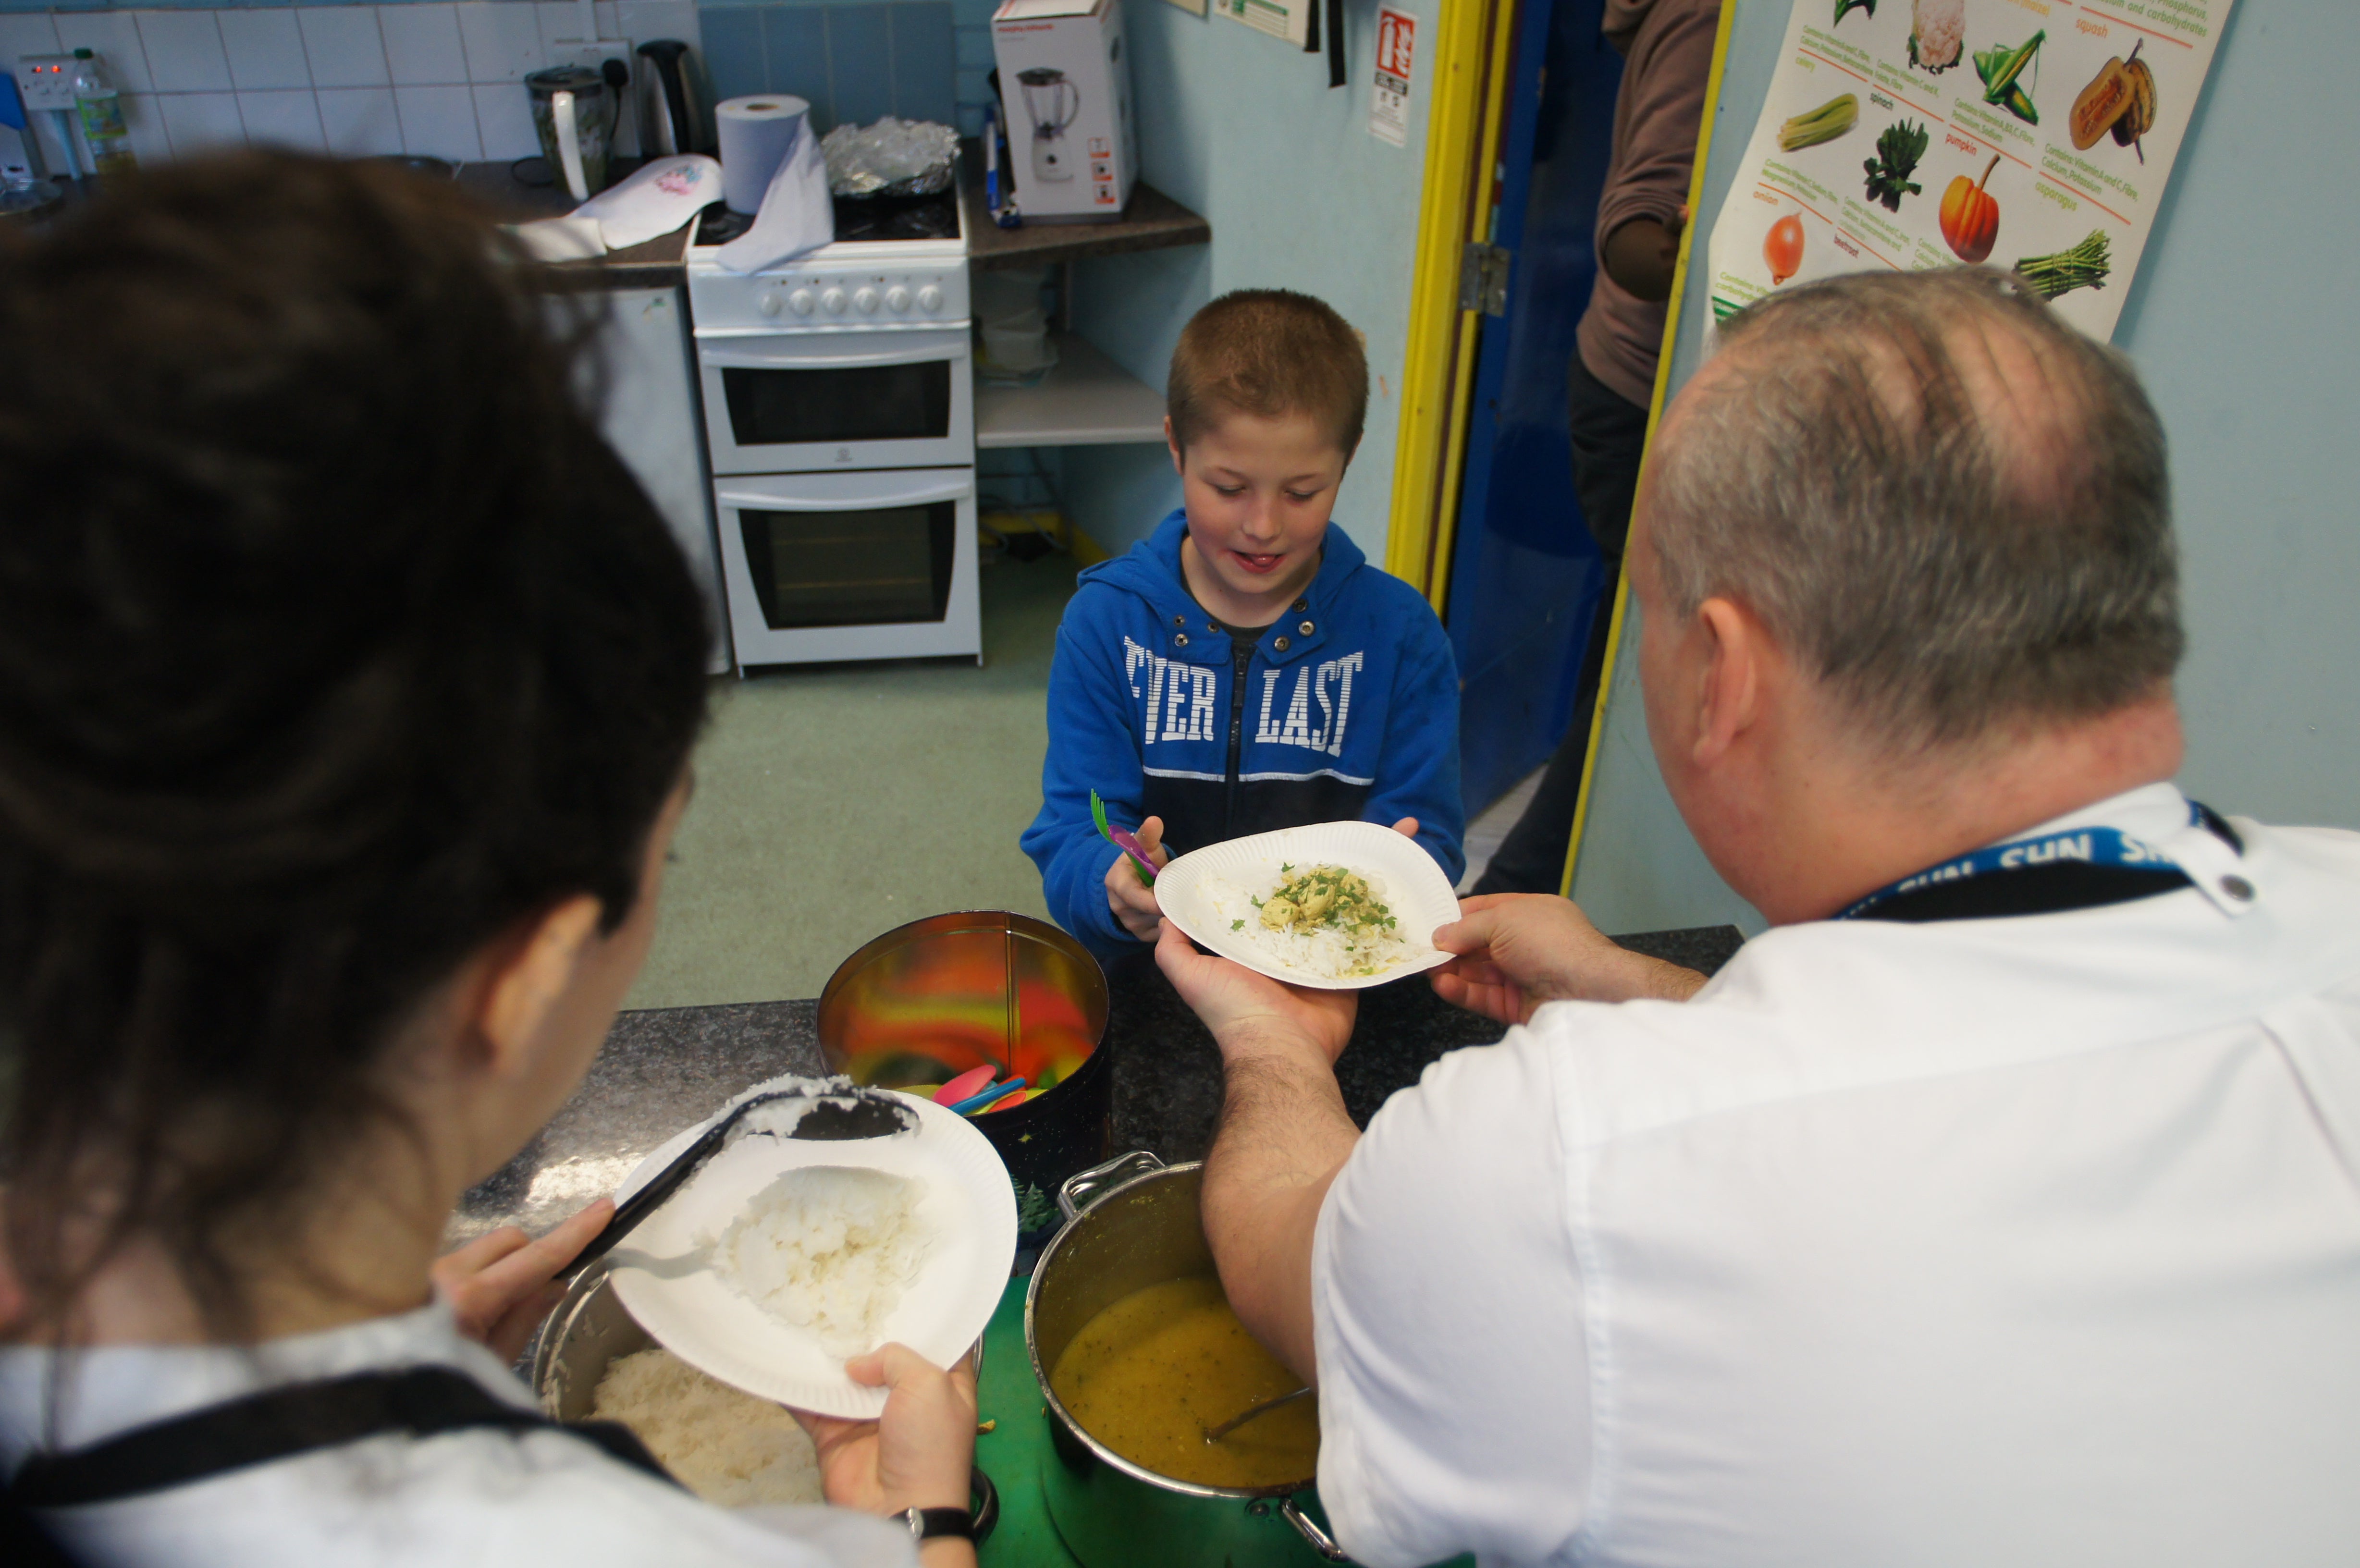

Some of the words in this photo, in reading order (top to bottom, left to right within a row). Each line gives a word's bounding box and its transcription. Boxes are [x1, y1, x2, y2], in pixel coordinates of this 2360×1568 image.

[2127, 2, 2145, 14] and
[2147, 8, 2208, 37] carbohydrates
[2157, 0, 2207, 23] hosphorus,
[2076, 18, 2109, 38] squash
[1870, 92, 1894, 111] spinach
[1945, 133, 1978, 156] pumpkin
[2042, 156, 2068, 179] Calcium,
[2068, 170, 2102, 195] Potassium
[1753, 190, 1779, 206] onion
[2035, 181, 2078, 211] asparagus
[1833, 233, 1859, 259] beetroot
[1255, 650, 1364, 758] LAST
